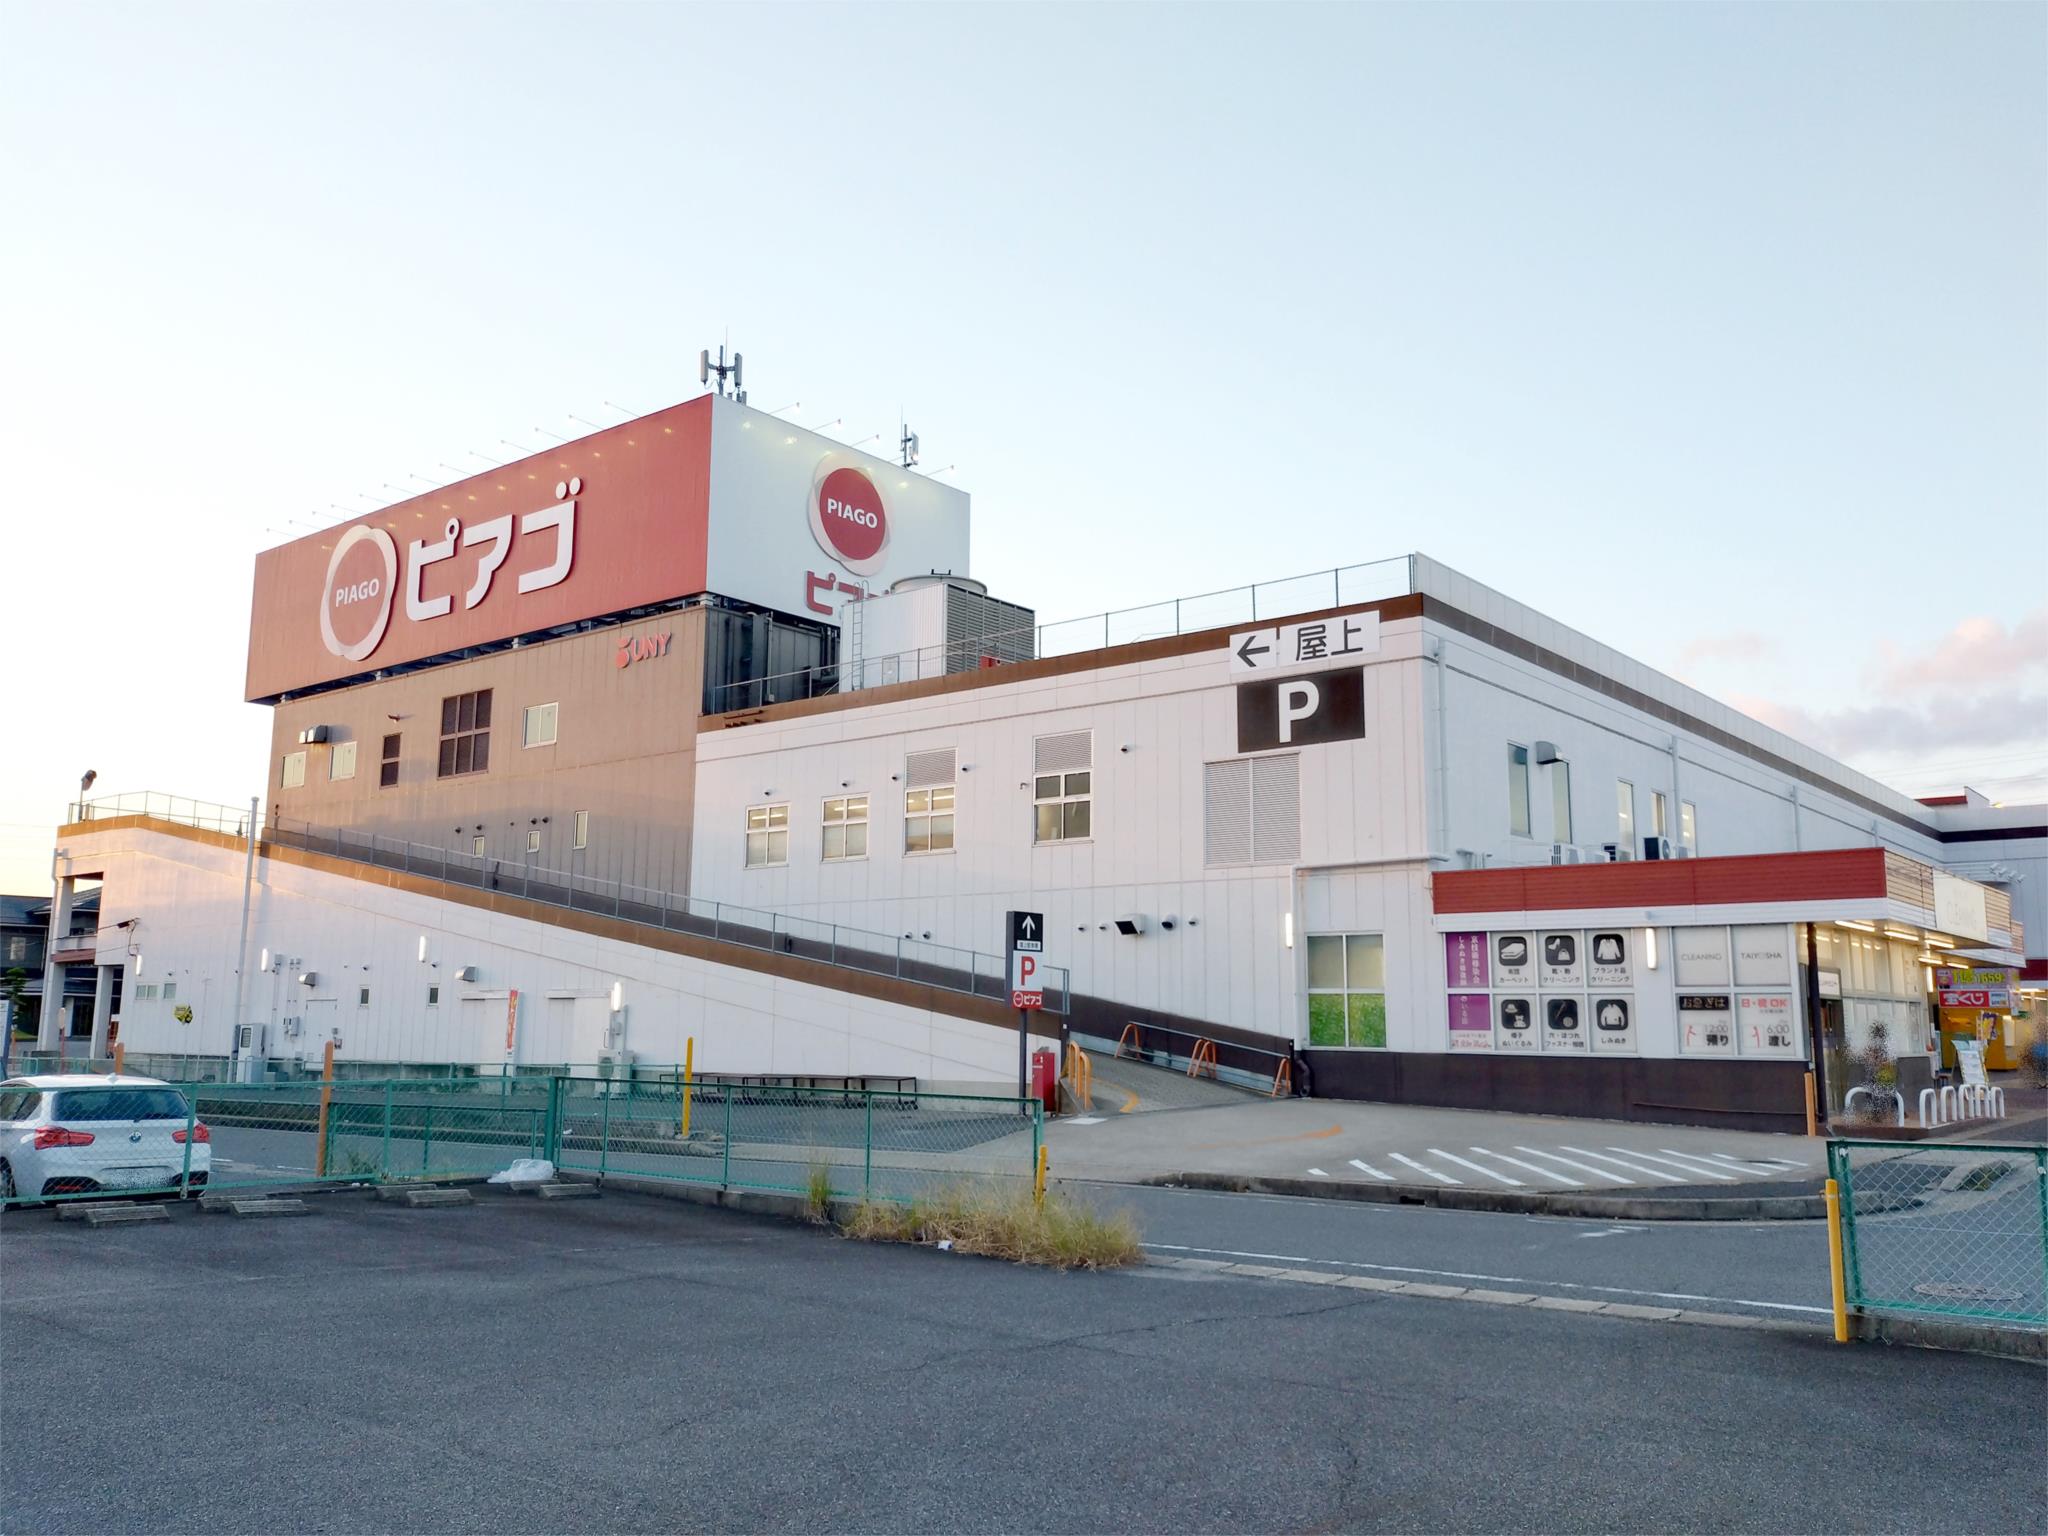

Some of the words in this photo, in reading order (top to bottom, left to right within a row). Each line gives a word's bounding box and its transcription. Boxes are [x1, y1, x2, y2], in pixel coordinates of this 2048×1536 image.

[827, 498, 878, 529] PIAGO
[406, 477, 581, 621] ピアゴ
[336, 578, 380, 607] PIAGO
[631, 631, 672, 662] UNY
[1296, 619, 1363, 661] 屋上
[1278, 680, 1320, 744] P
[1021, 956, 1035, 986] P
[1681, 953, 1722, 961] CLEANING
[1024, 994, 1042, 1005] ピアゴ
[1767, 1024, 1789, 1034] 6:00
